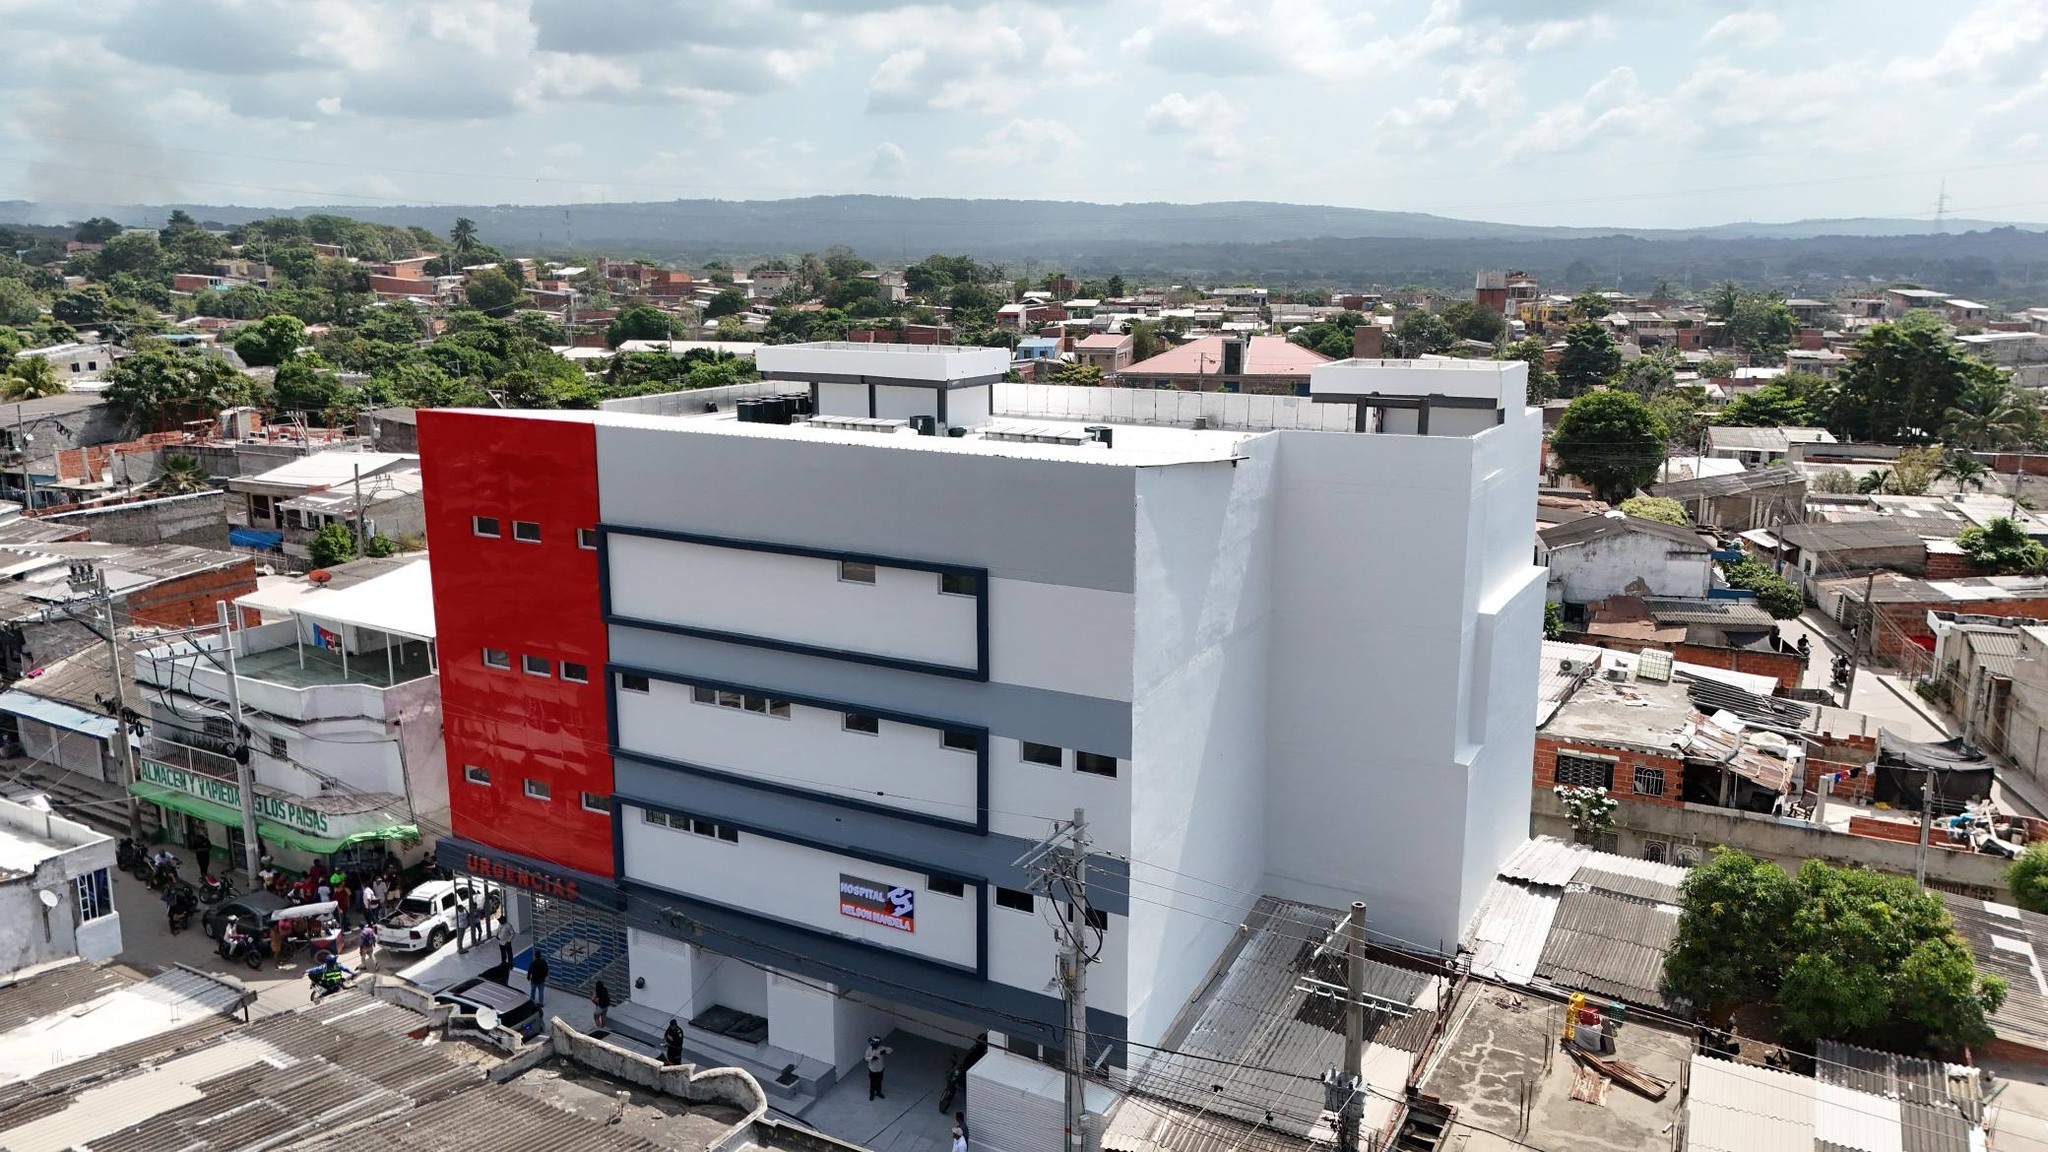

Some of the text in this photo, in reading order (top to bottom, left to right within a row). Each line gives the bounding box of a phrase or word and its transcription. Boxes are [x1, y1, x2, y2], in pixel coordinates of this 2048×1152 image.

[141, 761, 328, 832] ALMACEN Y VARIEDAS LOS PAISAS
[467, 853, 577, 900] URGENCIAS
[841, 882, 885, 903] HOSPITAL
[842, 903, 911, 931] NELSON MANDELA
